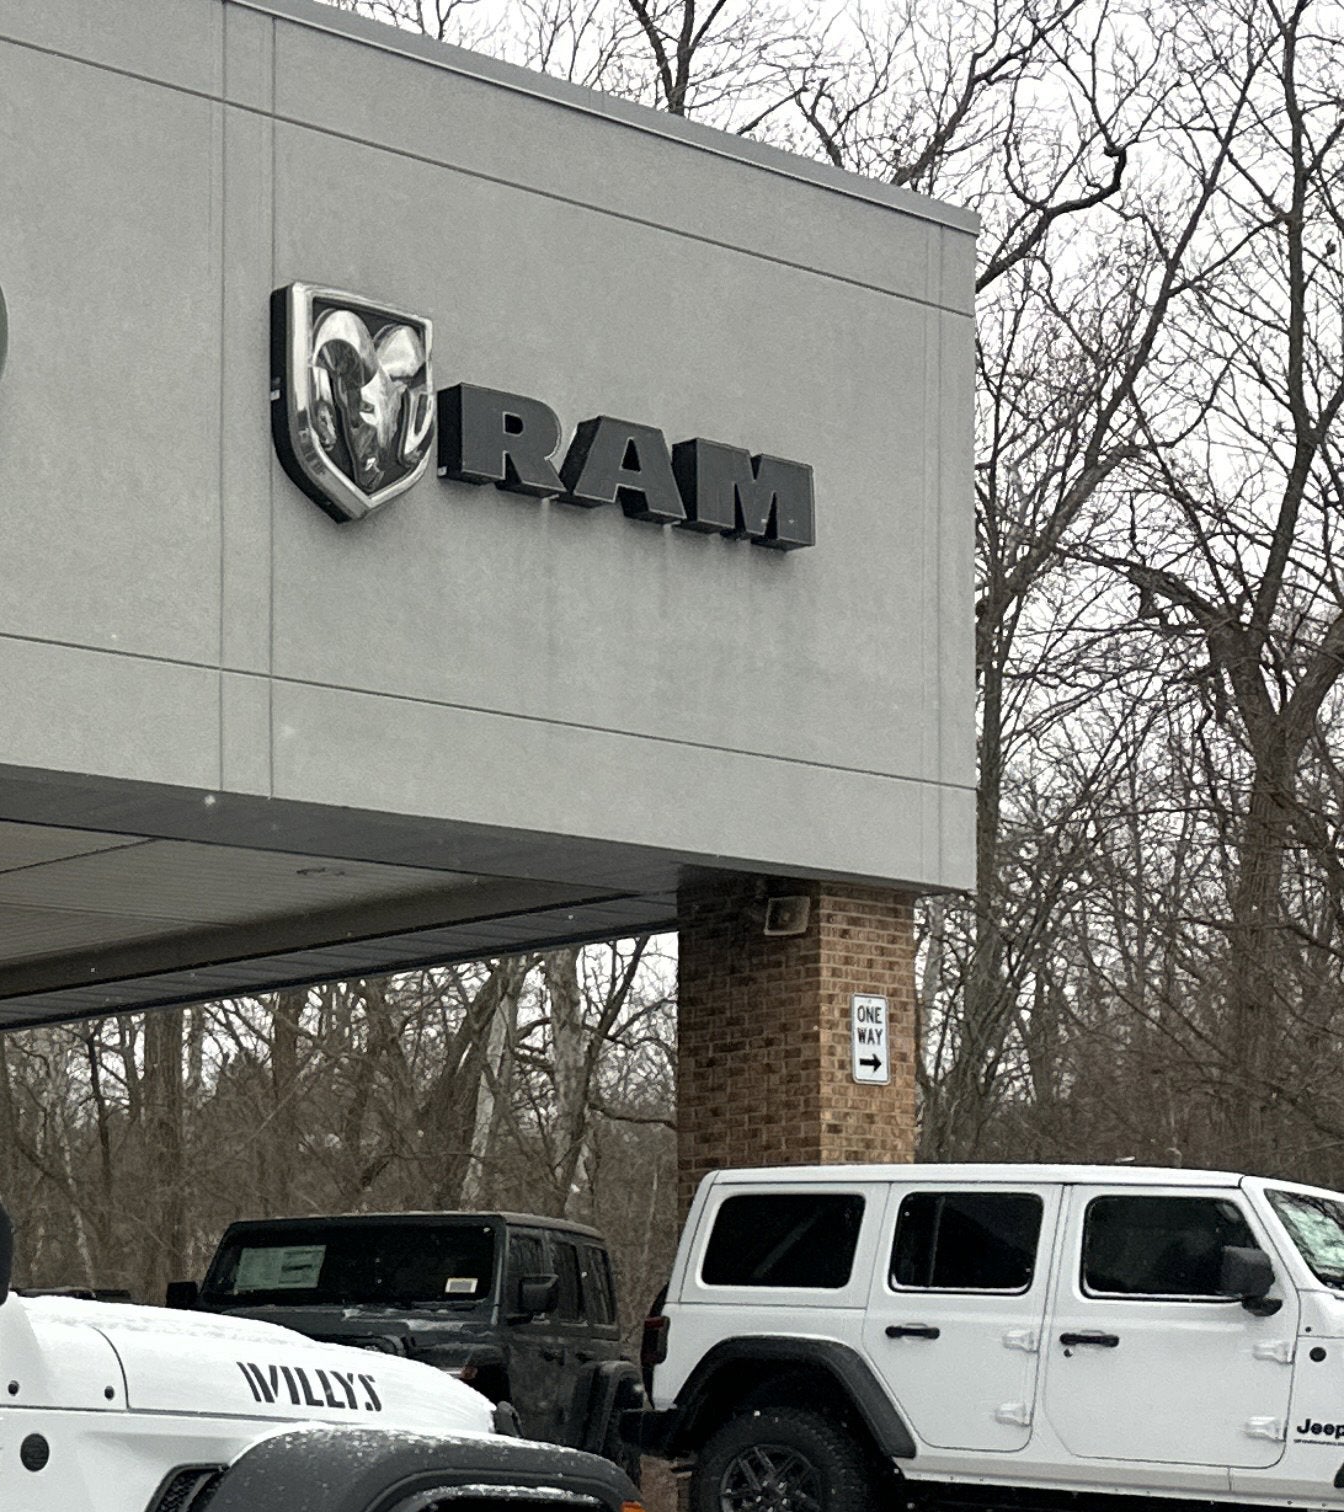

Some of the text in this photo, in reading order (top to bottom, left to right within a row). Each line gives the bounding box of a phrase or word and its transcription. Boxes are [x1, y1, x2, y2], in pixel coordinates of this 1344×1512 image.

[437, 382, 816, 551] RAM
[857, 1005, 883, 1024] ONE
[857, 1027, 883, 1045] WAY
[236, 1361, 382, 1412] WILLYS
[1296, 1418, 1344, 1440] Jeep
